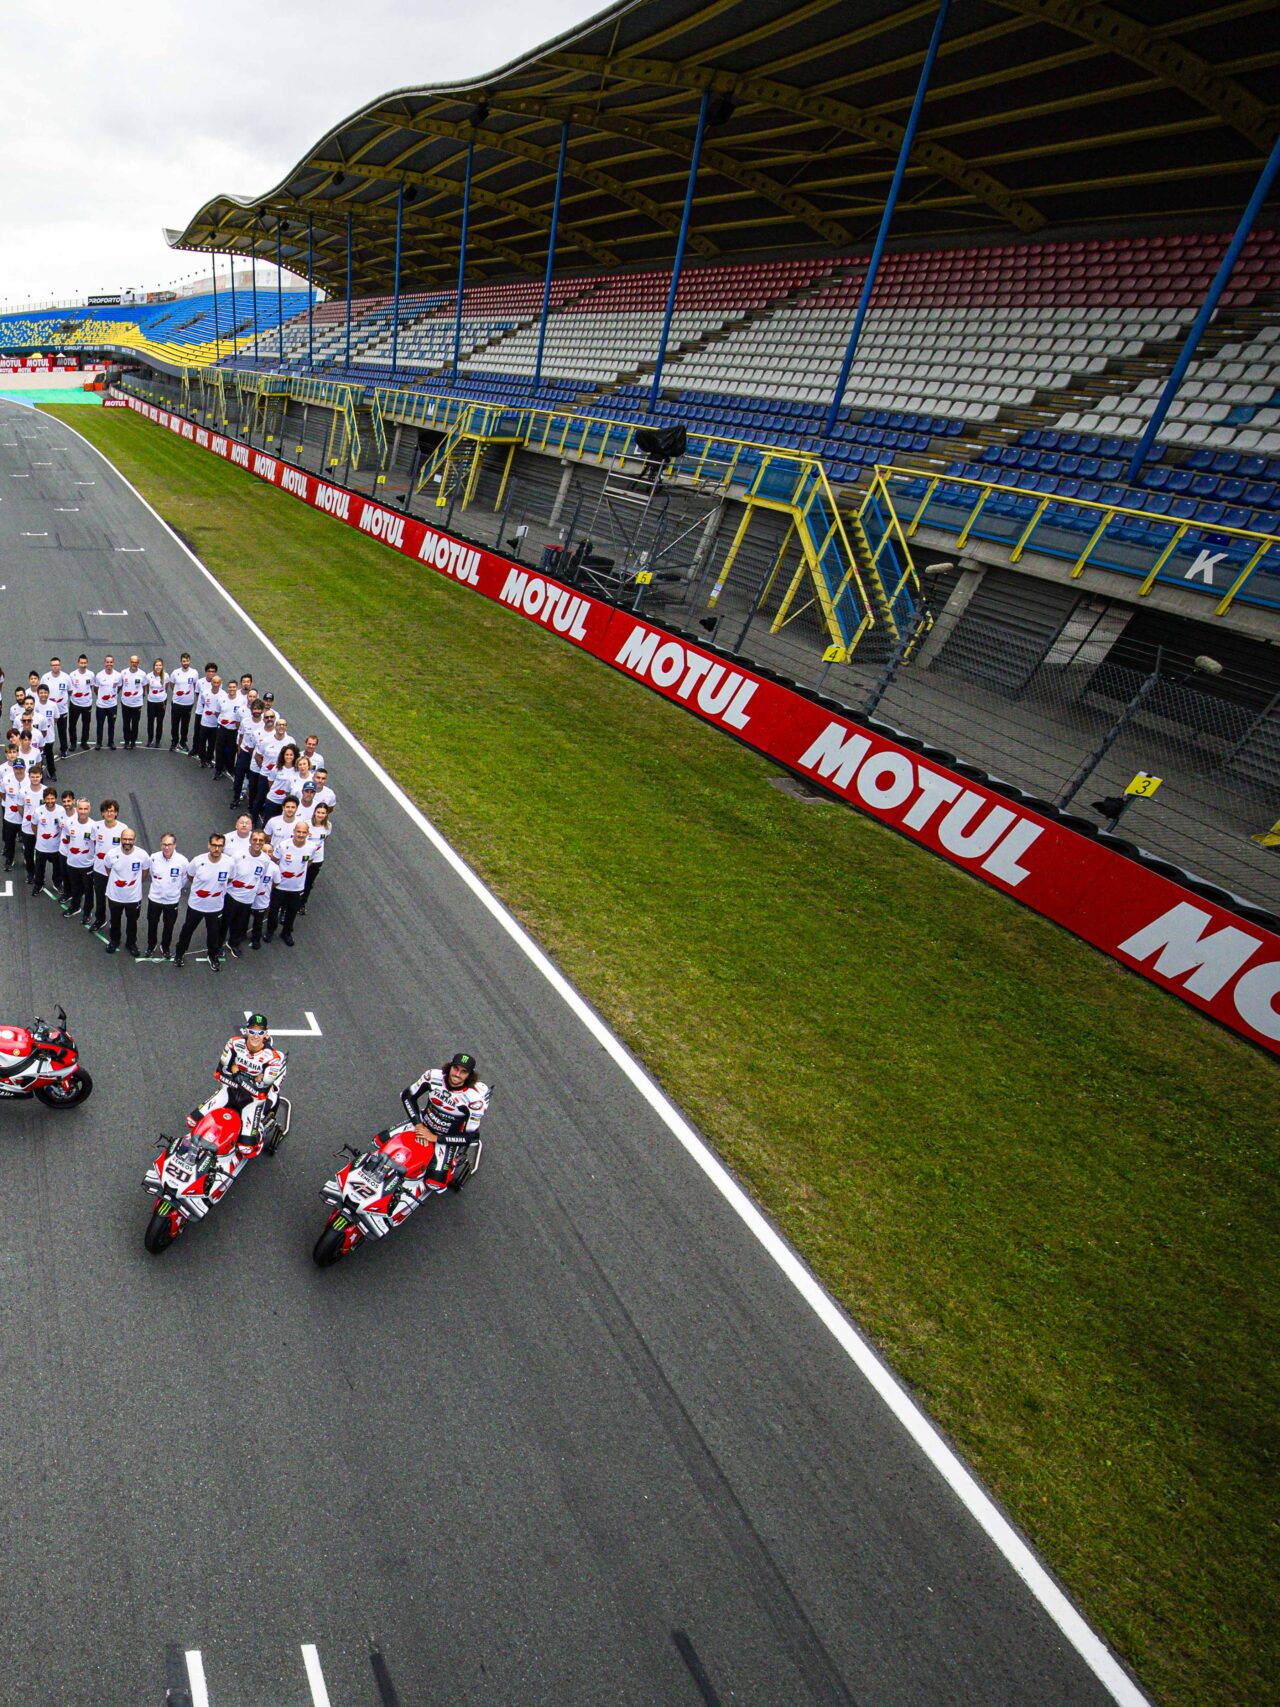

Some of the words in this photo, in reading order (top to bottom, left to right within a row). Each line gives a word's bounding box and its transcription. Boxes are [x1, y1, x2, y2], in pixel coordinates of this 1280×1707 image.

[88, 296, 121, 304] PROFORTO
[0, 359, 21, 367] MOTUL
[27, 358, 49, 367] MOTUL
[230, 443, 249, 468] MOTUL
[253, 453, 276, 482] MOTUL
[280, 467, 308, 499] MOTUL
[315, 483, 350, 520] MOTUL
[359, 503, 405, 548] MOTUL
[418, 530, 482, 586] MOTUL
[1184, 549, 1229, 584] K
[639, 573, 648, 583] 5
[499, 567, 591, 642] MOTUL
[829, 649, 838, 662] 4
[614, 625, 759, 730] MOTUL
[1135, 780, 1151, 795] 3
[798, 721, 1045, 887] MOTUL
[165, 1162, 193, 1183] 20
[348, 1181, 377, 1199] 42
